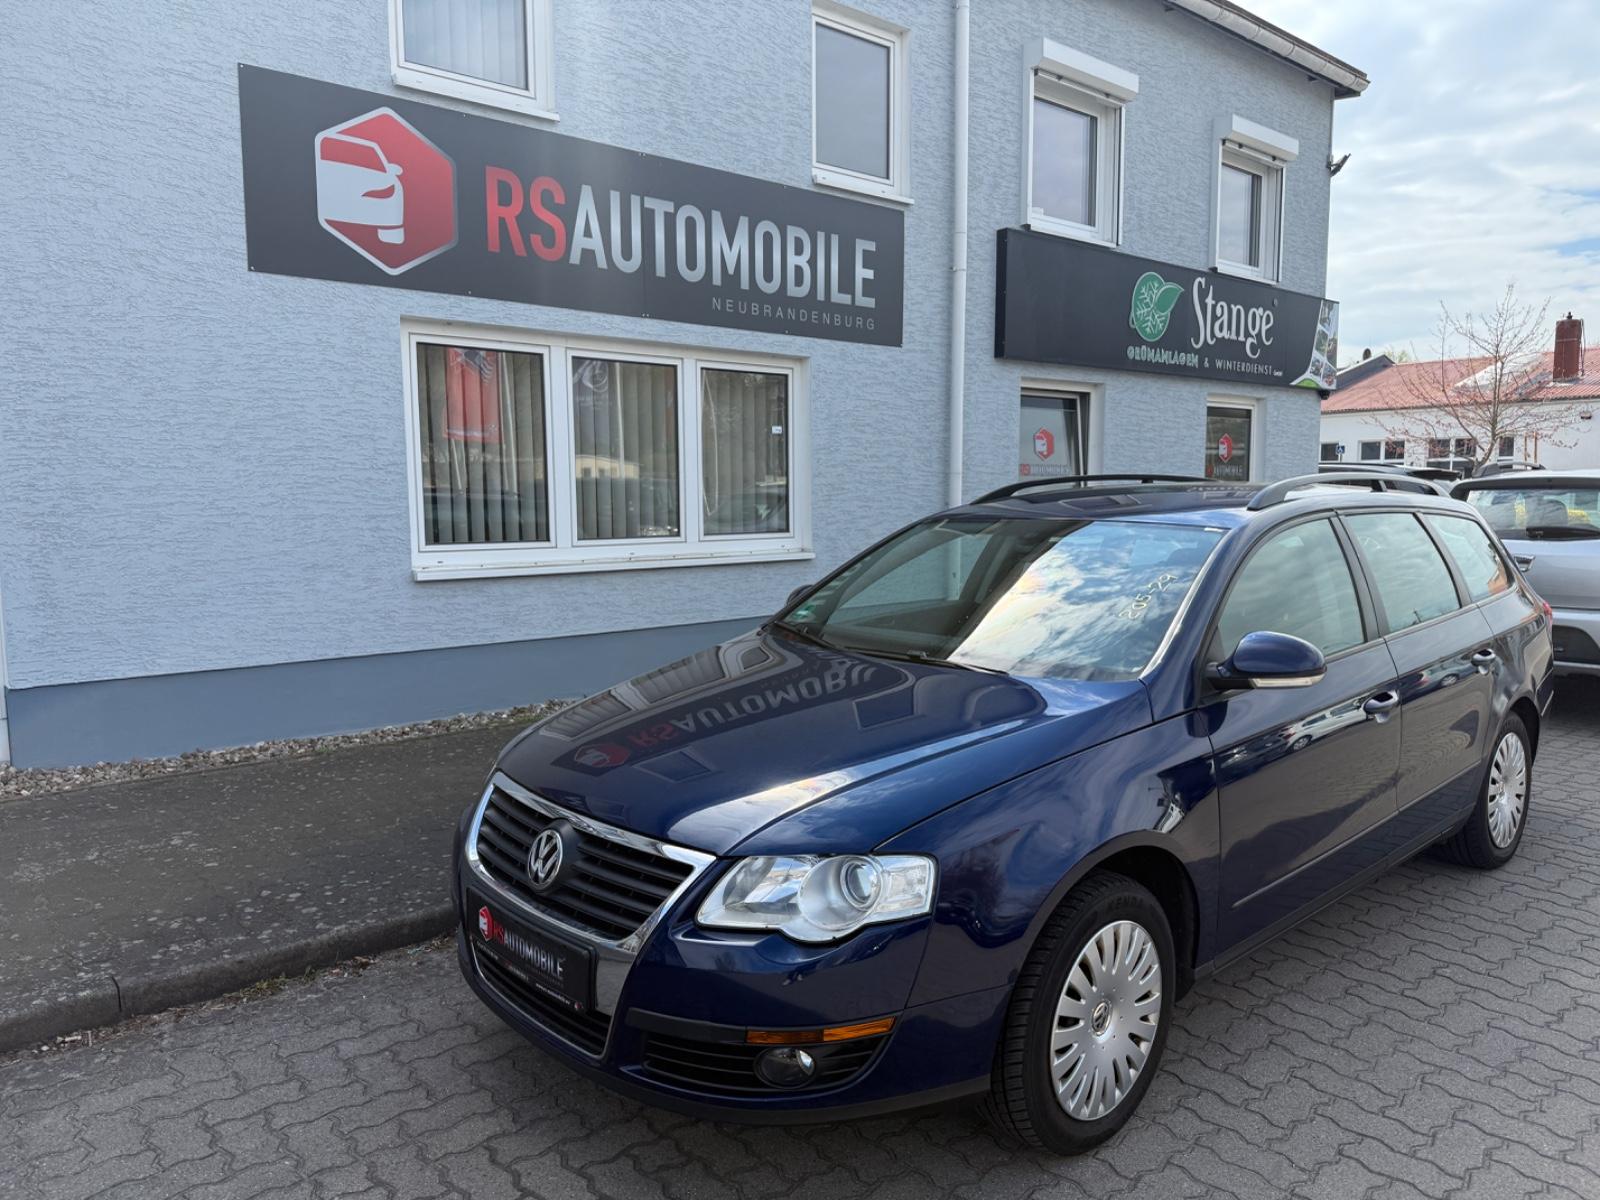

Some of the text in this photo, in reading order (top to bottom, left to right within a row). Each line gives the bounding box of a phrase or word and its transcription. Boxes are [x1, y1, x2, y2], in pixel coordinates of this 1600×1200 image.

[712, 297, 875, 331] NEUBRANDENBURG
[1191, 277, 1274, 358] Stange
[1203, 357, 1210, 368] &
[1215, 359, 1272, 376] WINTERDIENST
